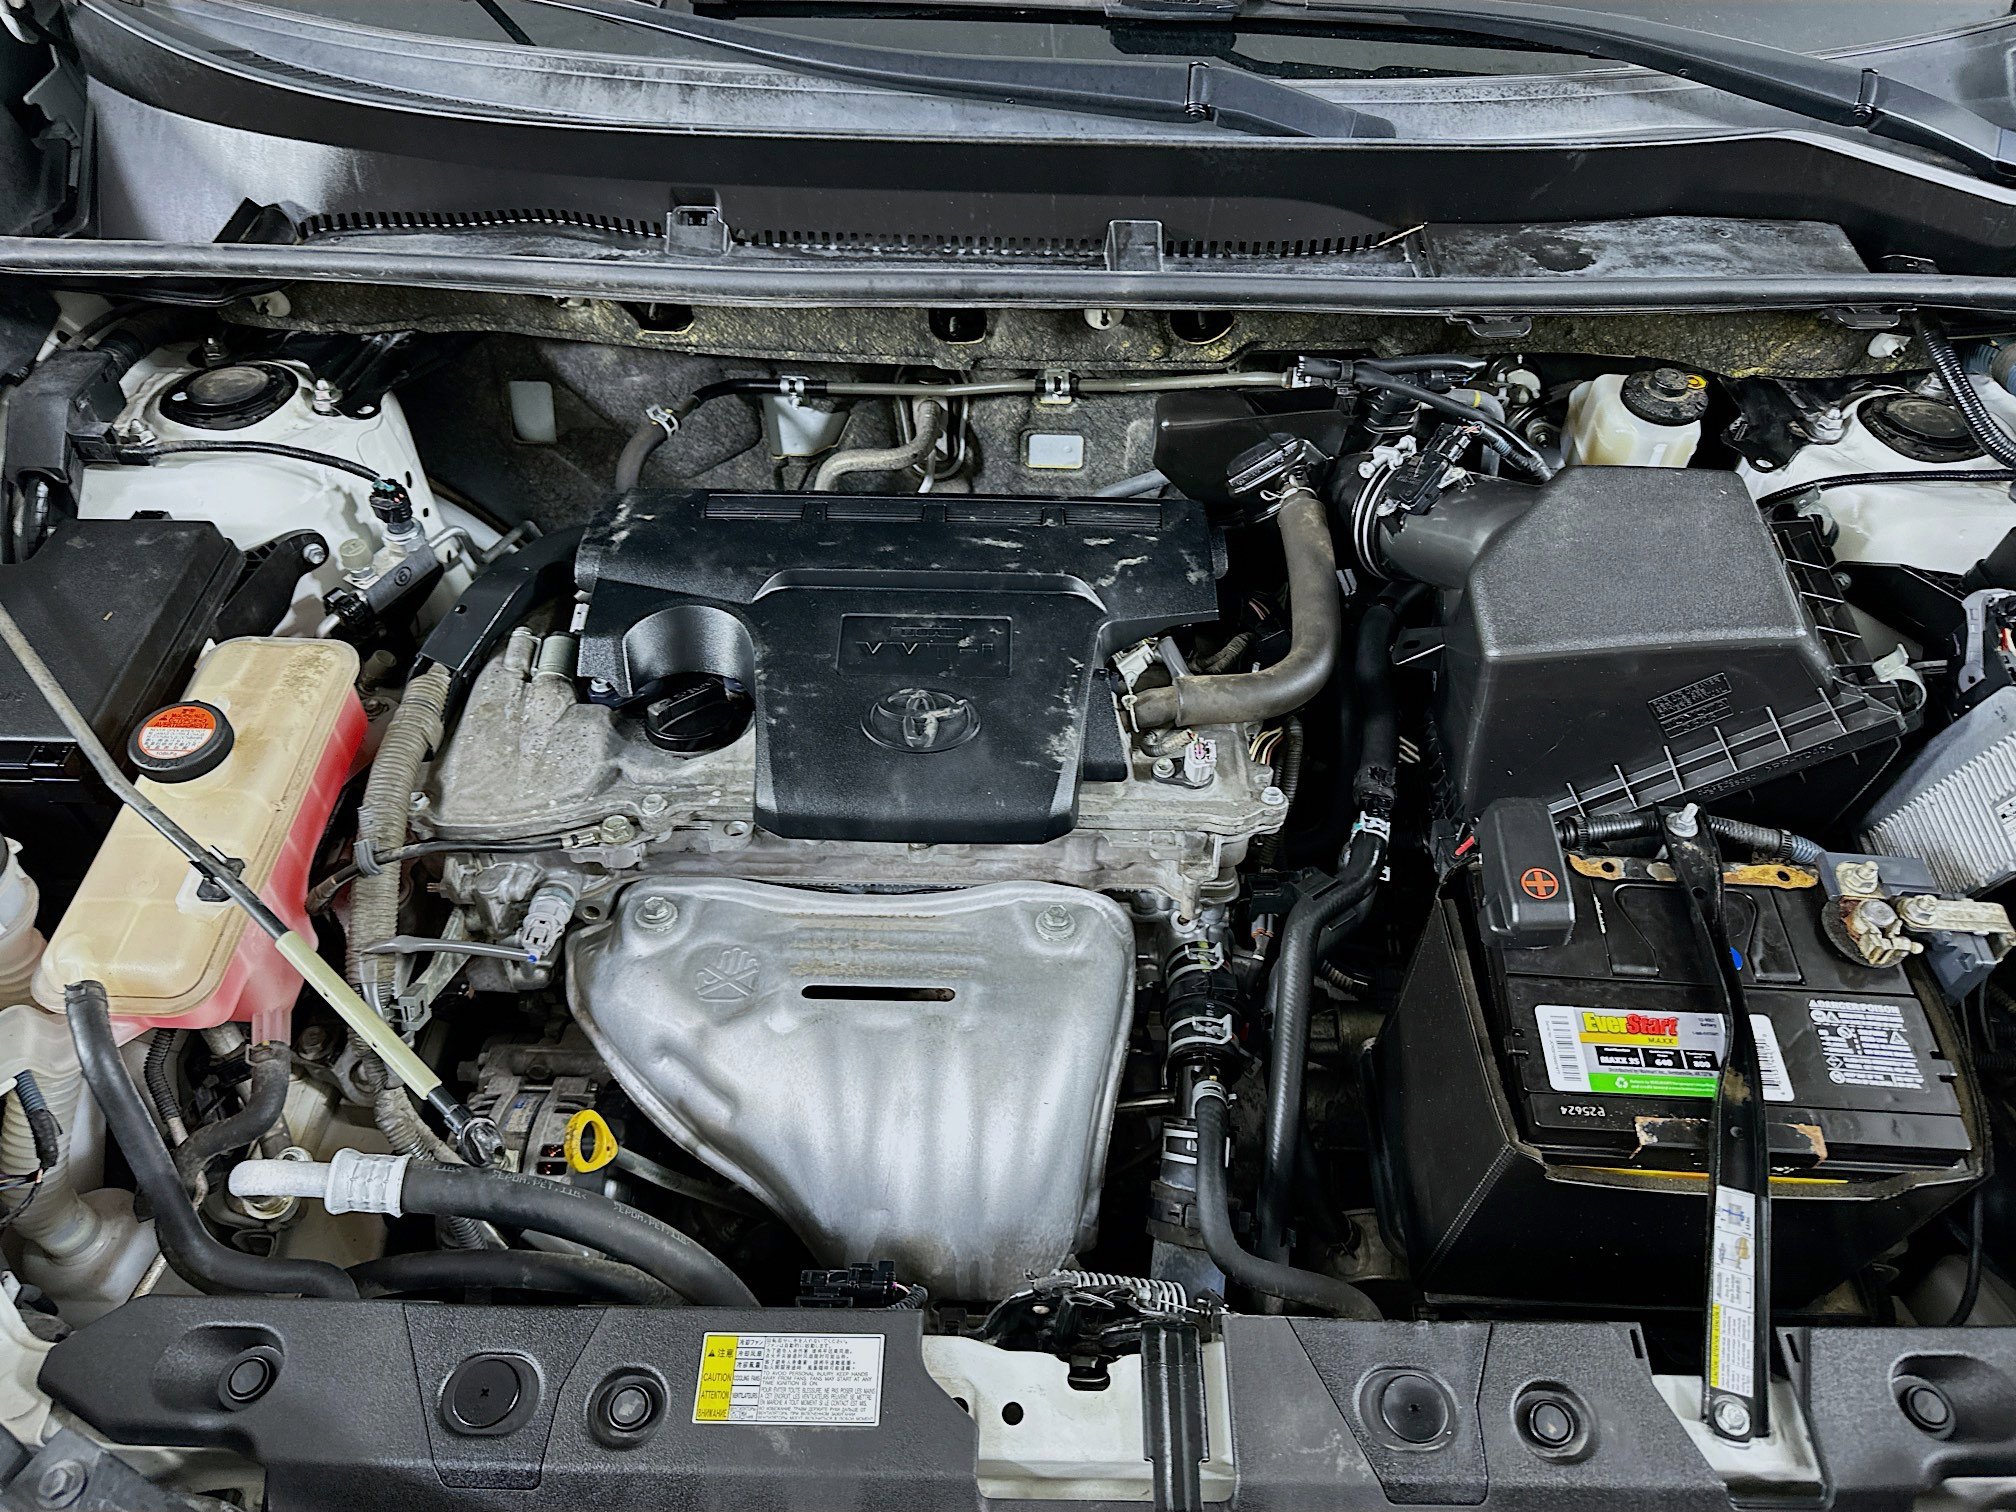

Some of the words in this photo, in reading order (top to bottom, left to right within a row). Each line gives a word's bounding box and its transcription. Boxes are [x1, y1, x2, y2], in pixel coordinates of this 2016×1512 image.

[1582, 1011, 1678, 1036] EverStart
[1600, 1056, 1627, 1065] MAXX
[703, 1373, 732, 1382] CAUTION
[700, 1390, 730, 1400] ATTENTION
